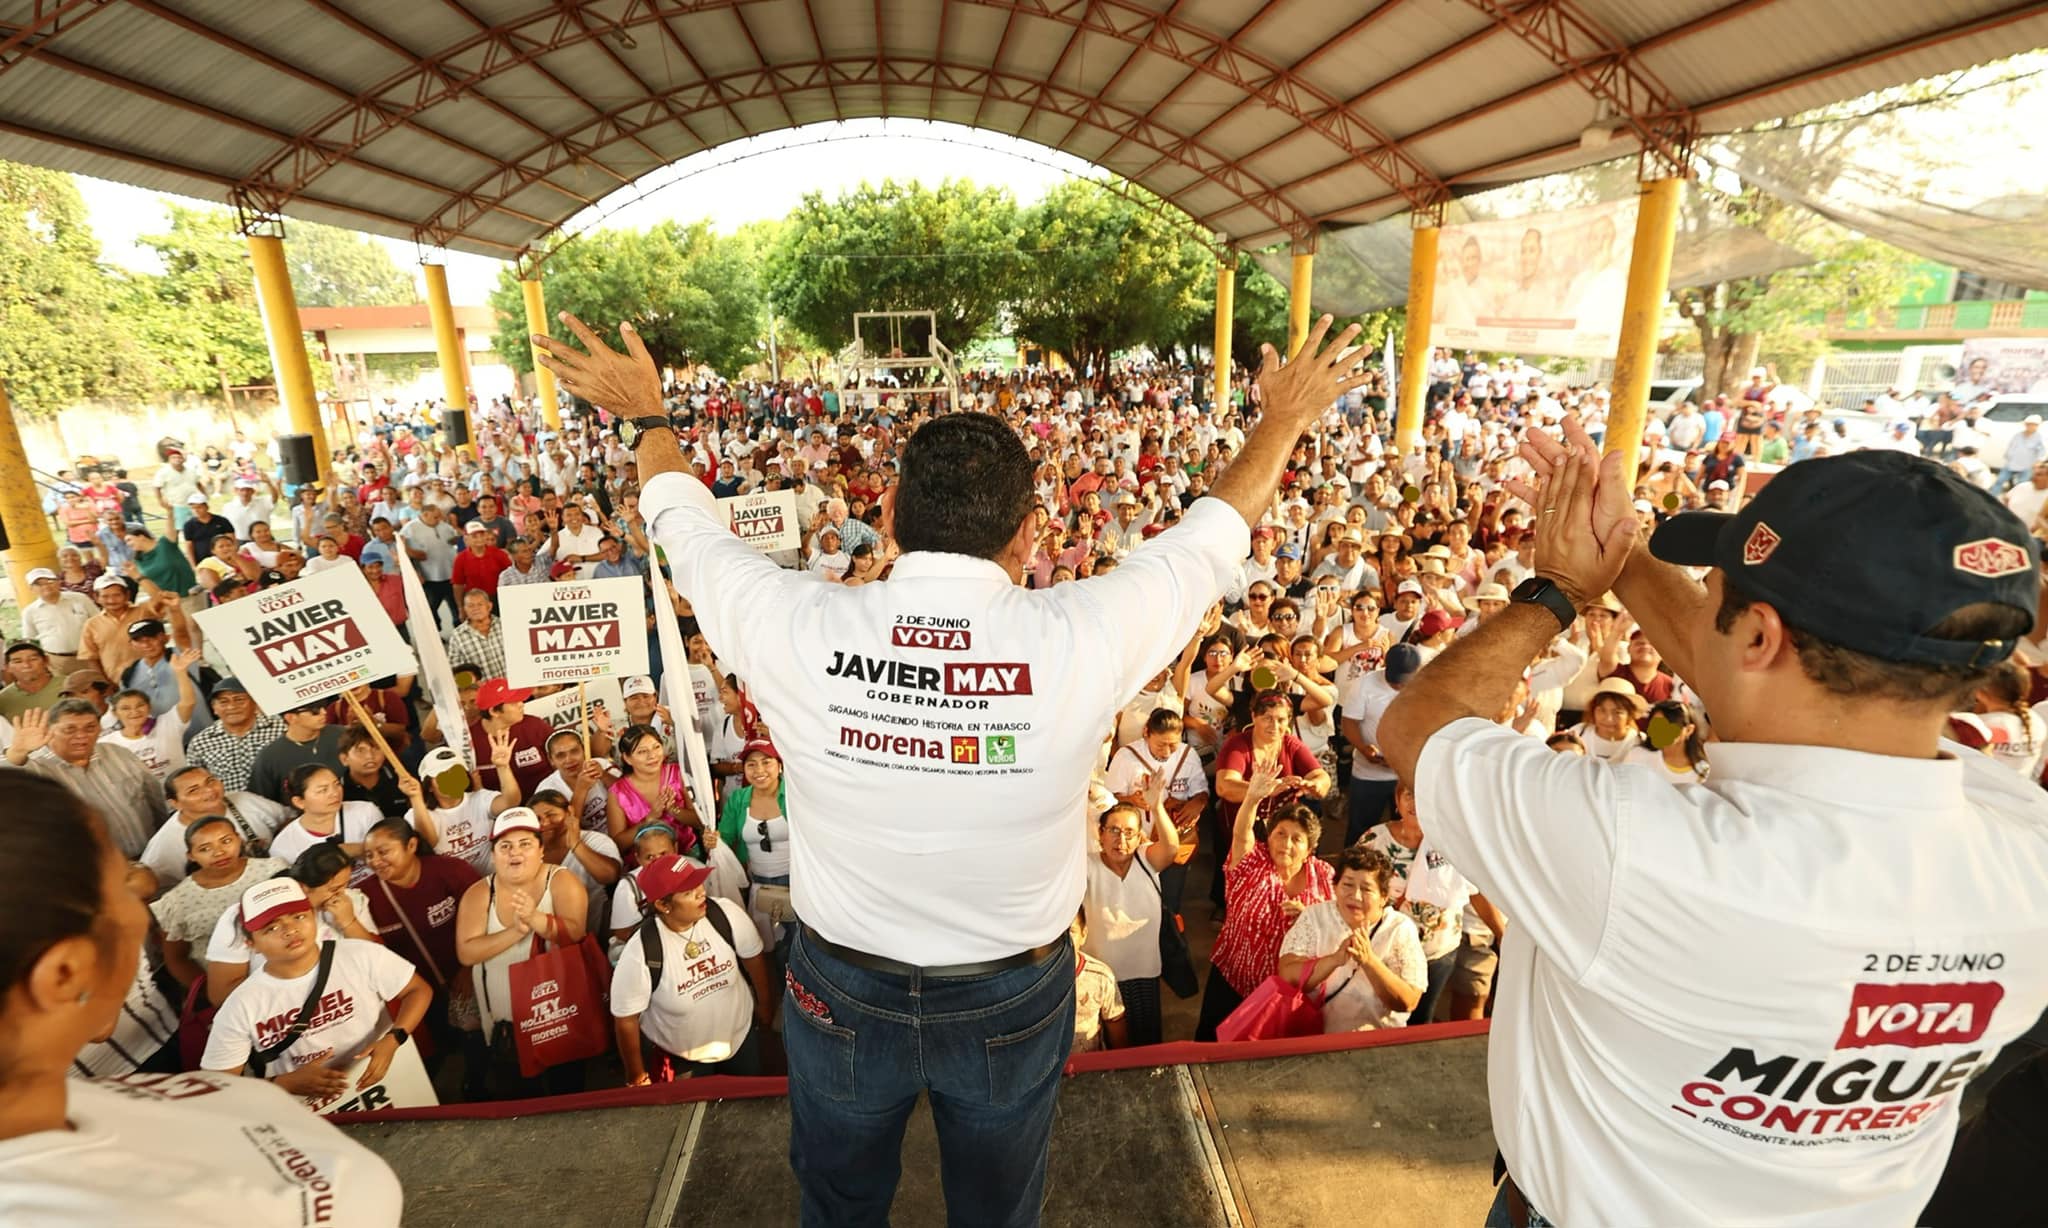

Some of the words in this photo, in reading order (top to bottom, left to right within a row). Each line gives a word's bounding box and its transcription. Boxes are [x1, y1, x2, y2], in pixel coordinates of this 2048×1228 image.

[734, 506, 782, 521] JAVIER
[738, 518, 778, 537] MAY
[260, 593, 304, 613] VOTA
[553, 590, 591, 601] VOTA
[244, 599, 348, 645] JAVIER
[529, 602, 618, 625] JAVIER
[896, 615, 903, 624] 2
[907, 616, 926, 625] DE
[927, 617, 970, 629] JUNIO
[263, 623, 350, 672] MAY
[537, 624, 611, 651] MAY
[896, 628, 967, 648] VOTA
[278, 648, 372, 684] GOBERNADOR
[534, 649, 620, 663] GOBERNADOR
[543, 667, 590, 679] morena
[826, 651, 941, 691] JAVIER
[952, 667, 1021, 692] MAY
[296, 674, 348, 698] morena
[866, 690, 990, 710] GOBERNADOR
[828, 704, 868, 719] SIGAMOS
[871, 713, 919, 726] HACIENDO
[923, 719, 963, 731] HISTORIA
[968, 723, 980, 731] EN
[985, 723, 1031, 731] TABASCO
[840, 726, 945, 760] morena
[954, 745, 976, 762] PT
[448, 832, 473, 848] TEY
[687, 955, 716, 977] TEY
[1863, 953, 1879, 972] 2
[1887, 954, 1921, 973] DE
[1926, 952, 2005, 972] JUNIO
[677, 960, 732, 992] MOLLINEDO
[693, 980, 729, 1000] morena
[520, 1005, 578, 1029] MOLLINEDO
[531, 997, 560, 1017] TEY
[1855, 1002, 1975, 1038] VOTA
[531, 1024, 568, 1042] morena
[1703, 1046, 1986, 1105] MIGUE
[1702, 1116, 1787, 1146] PRESIDENTE
[278, 1148, 333, 1222] morena
